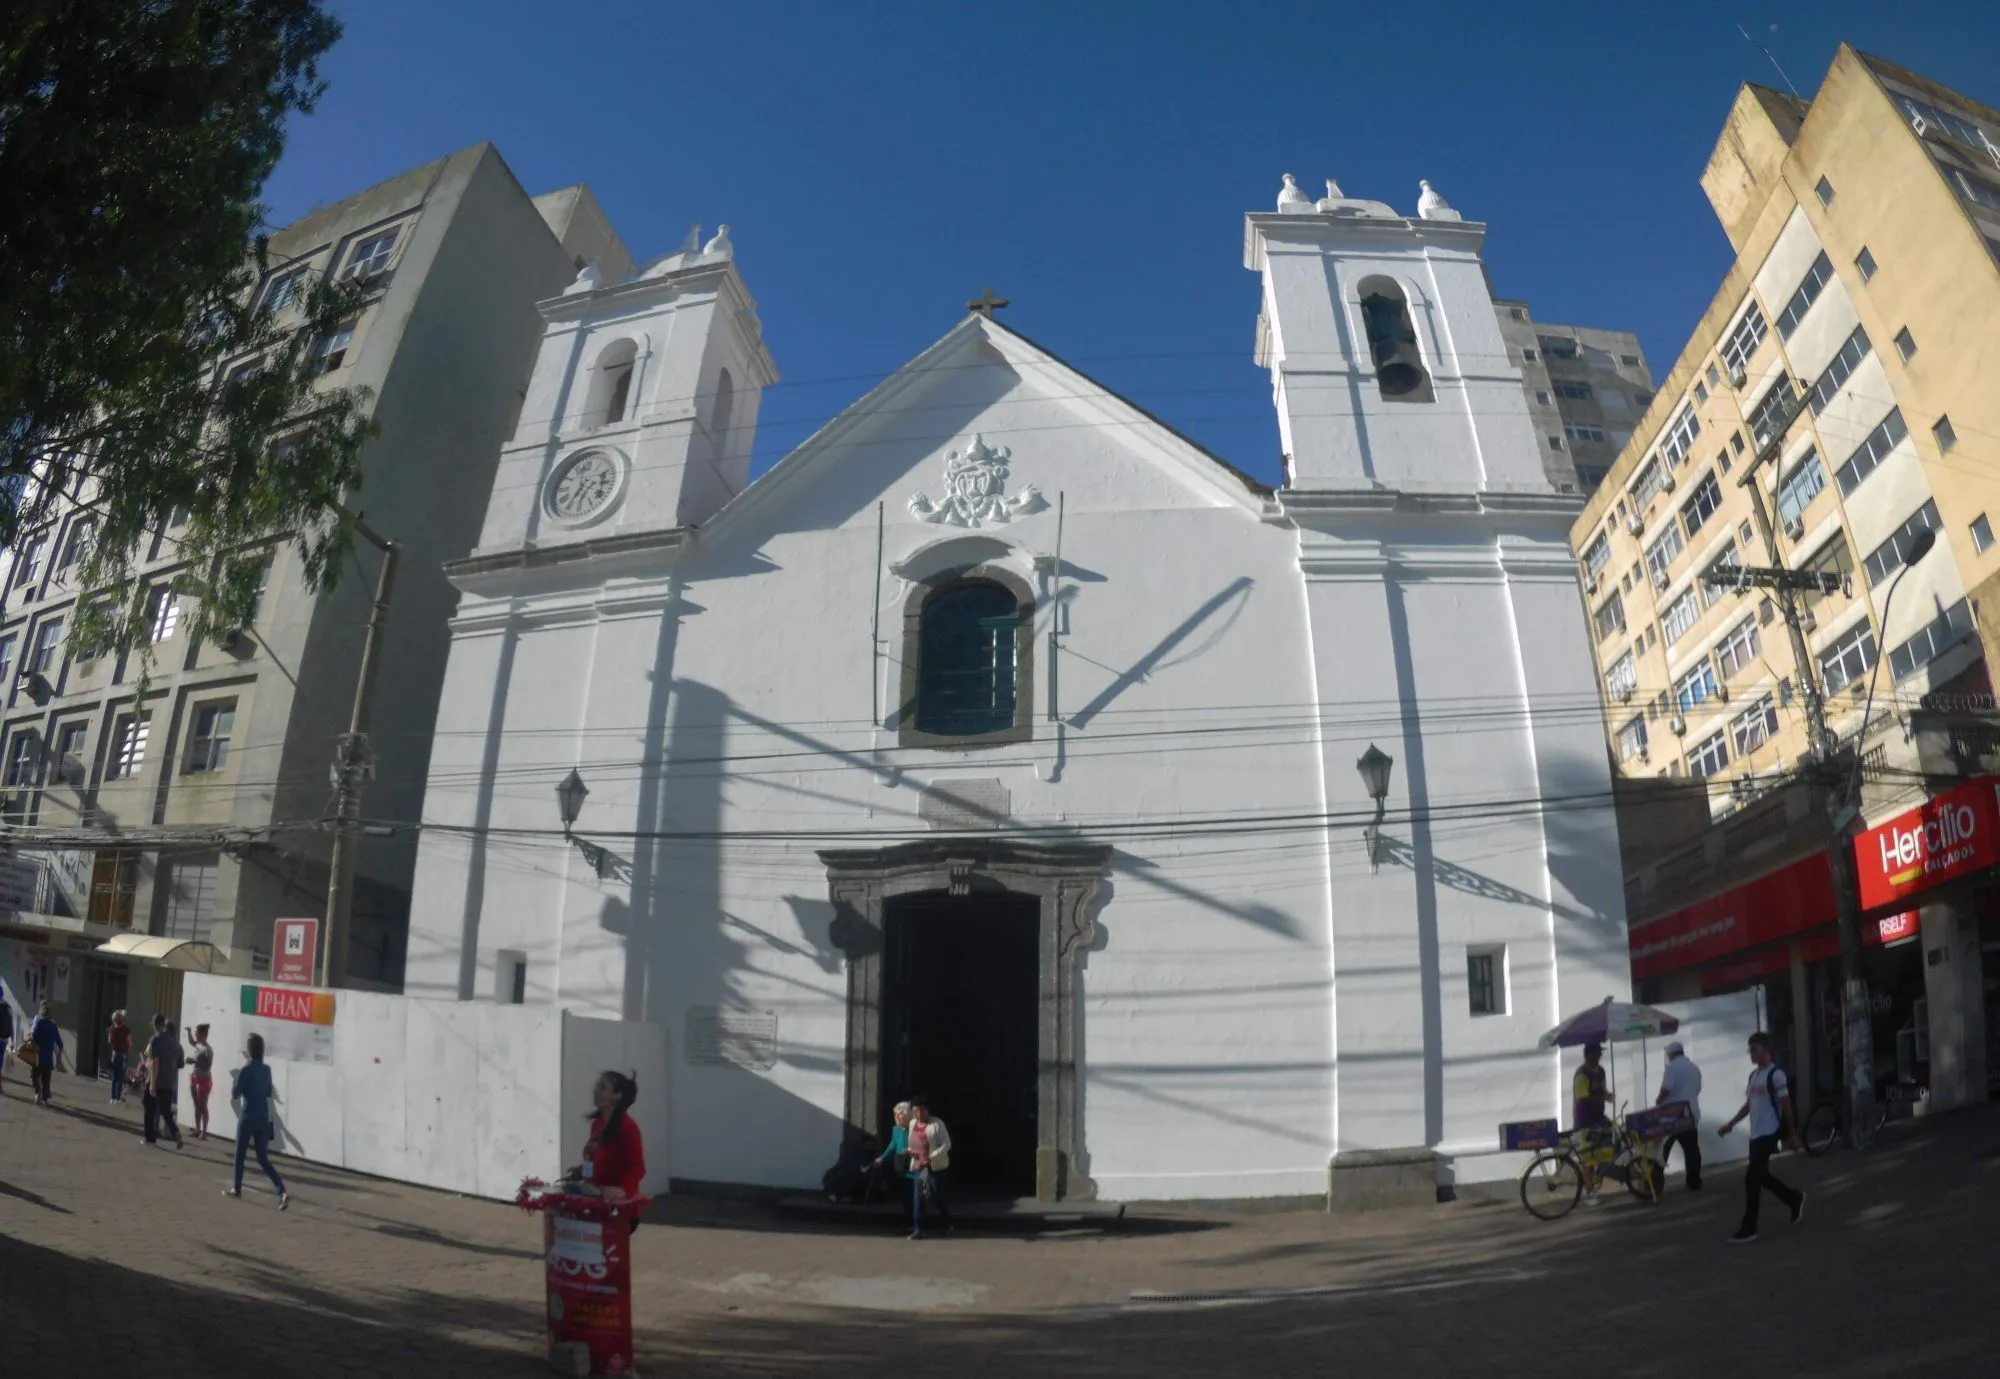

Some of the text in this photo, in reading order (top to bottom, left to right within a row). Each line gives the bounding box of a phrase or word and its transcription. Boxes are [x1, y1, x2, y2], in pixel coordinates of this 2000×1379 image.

[1879, 803, 1975, 874] Hercílio
[1924, 844, 1975, 874] CALÇADOS
[257, 990, 312, 1019] IPHAN
